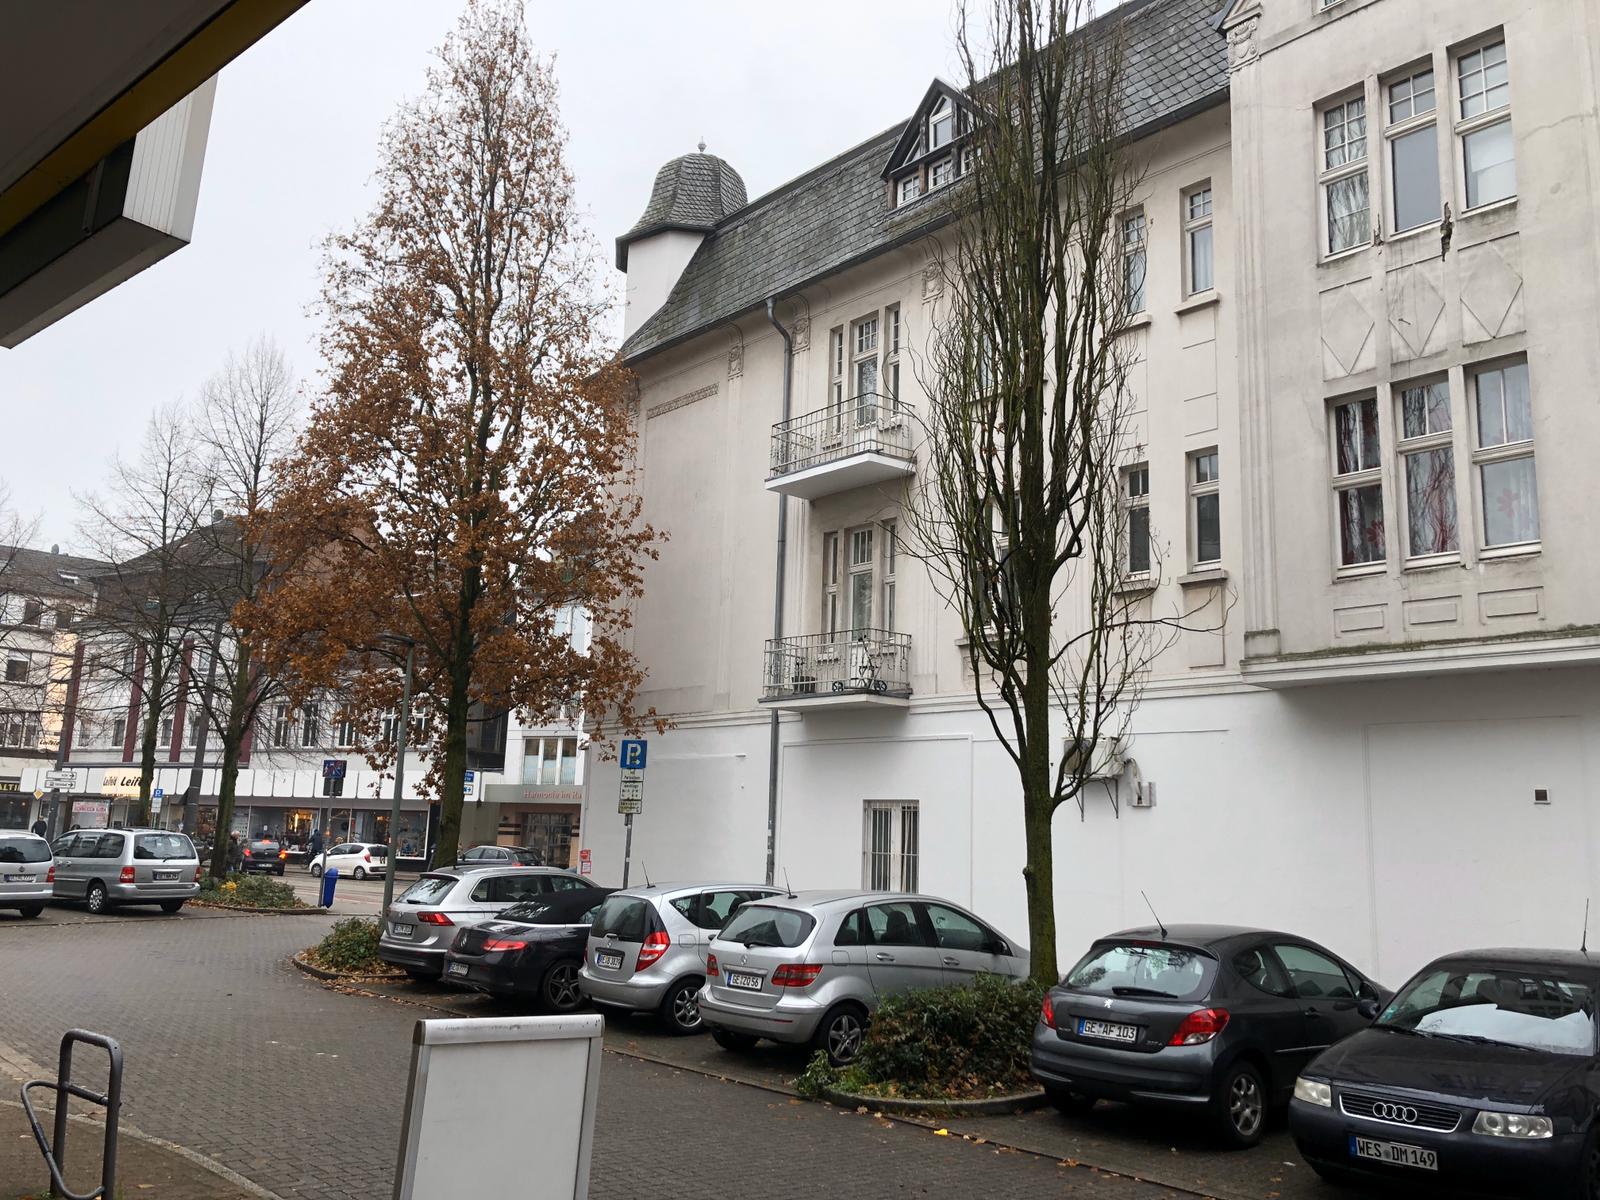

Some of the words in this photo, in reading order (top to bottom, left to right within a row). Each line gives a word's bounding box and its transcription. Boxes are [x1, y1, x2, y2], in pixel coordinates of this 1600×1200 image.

[1084, 1021, 1097, 1033] GE
[1102, 1023, 1115, 1036] AF
[1116, 1026, 1135, 1039] 103
[1357, 1139, 1382, 1158] WES
[1391, 1145, 1409, 1163] DM
[1411, 1150, 1435, 1168] 149
